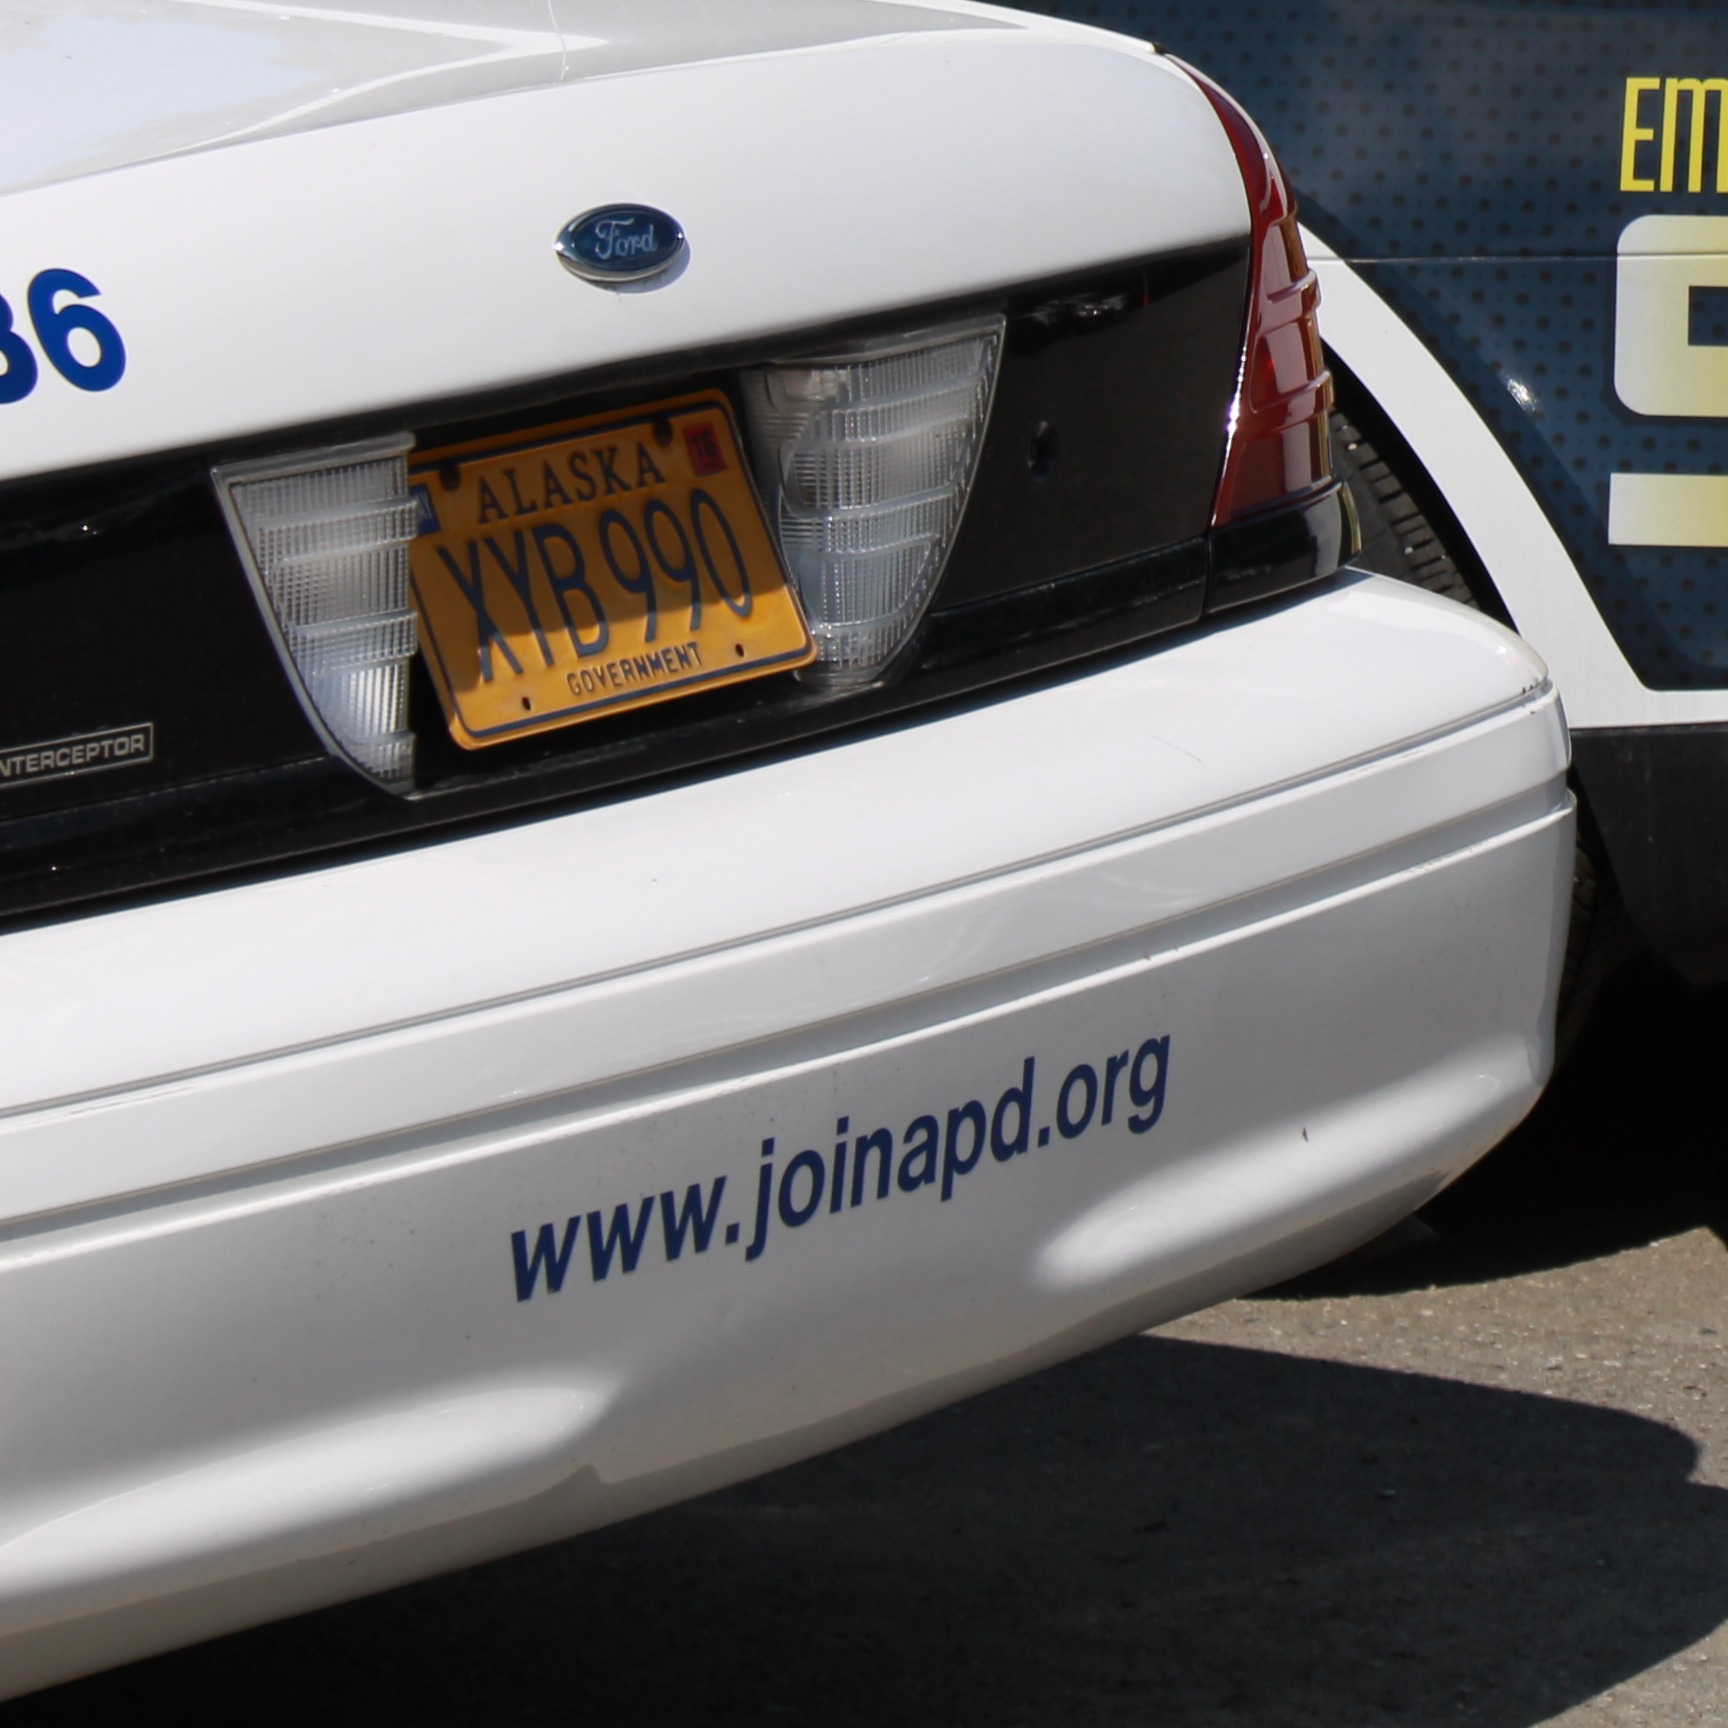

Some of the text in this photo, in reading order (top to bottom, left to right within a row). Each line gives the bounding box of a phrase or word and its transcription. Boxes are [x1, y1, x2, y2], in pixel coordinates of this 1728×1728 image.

[594, 217, 658, 260] Ford
[477, 440, 666, 524] ALASKA
[566, 640, 704, 696] GOVERNMENT
[510, 1034, 1171, 1303] www.joinapd.org
